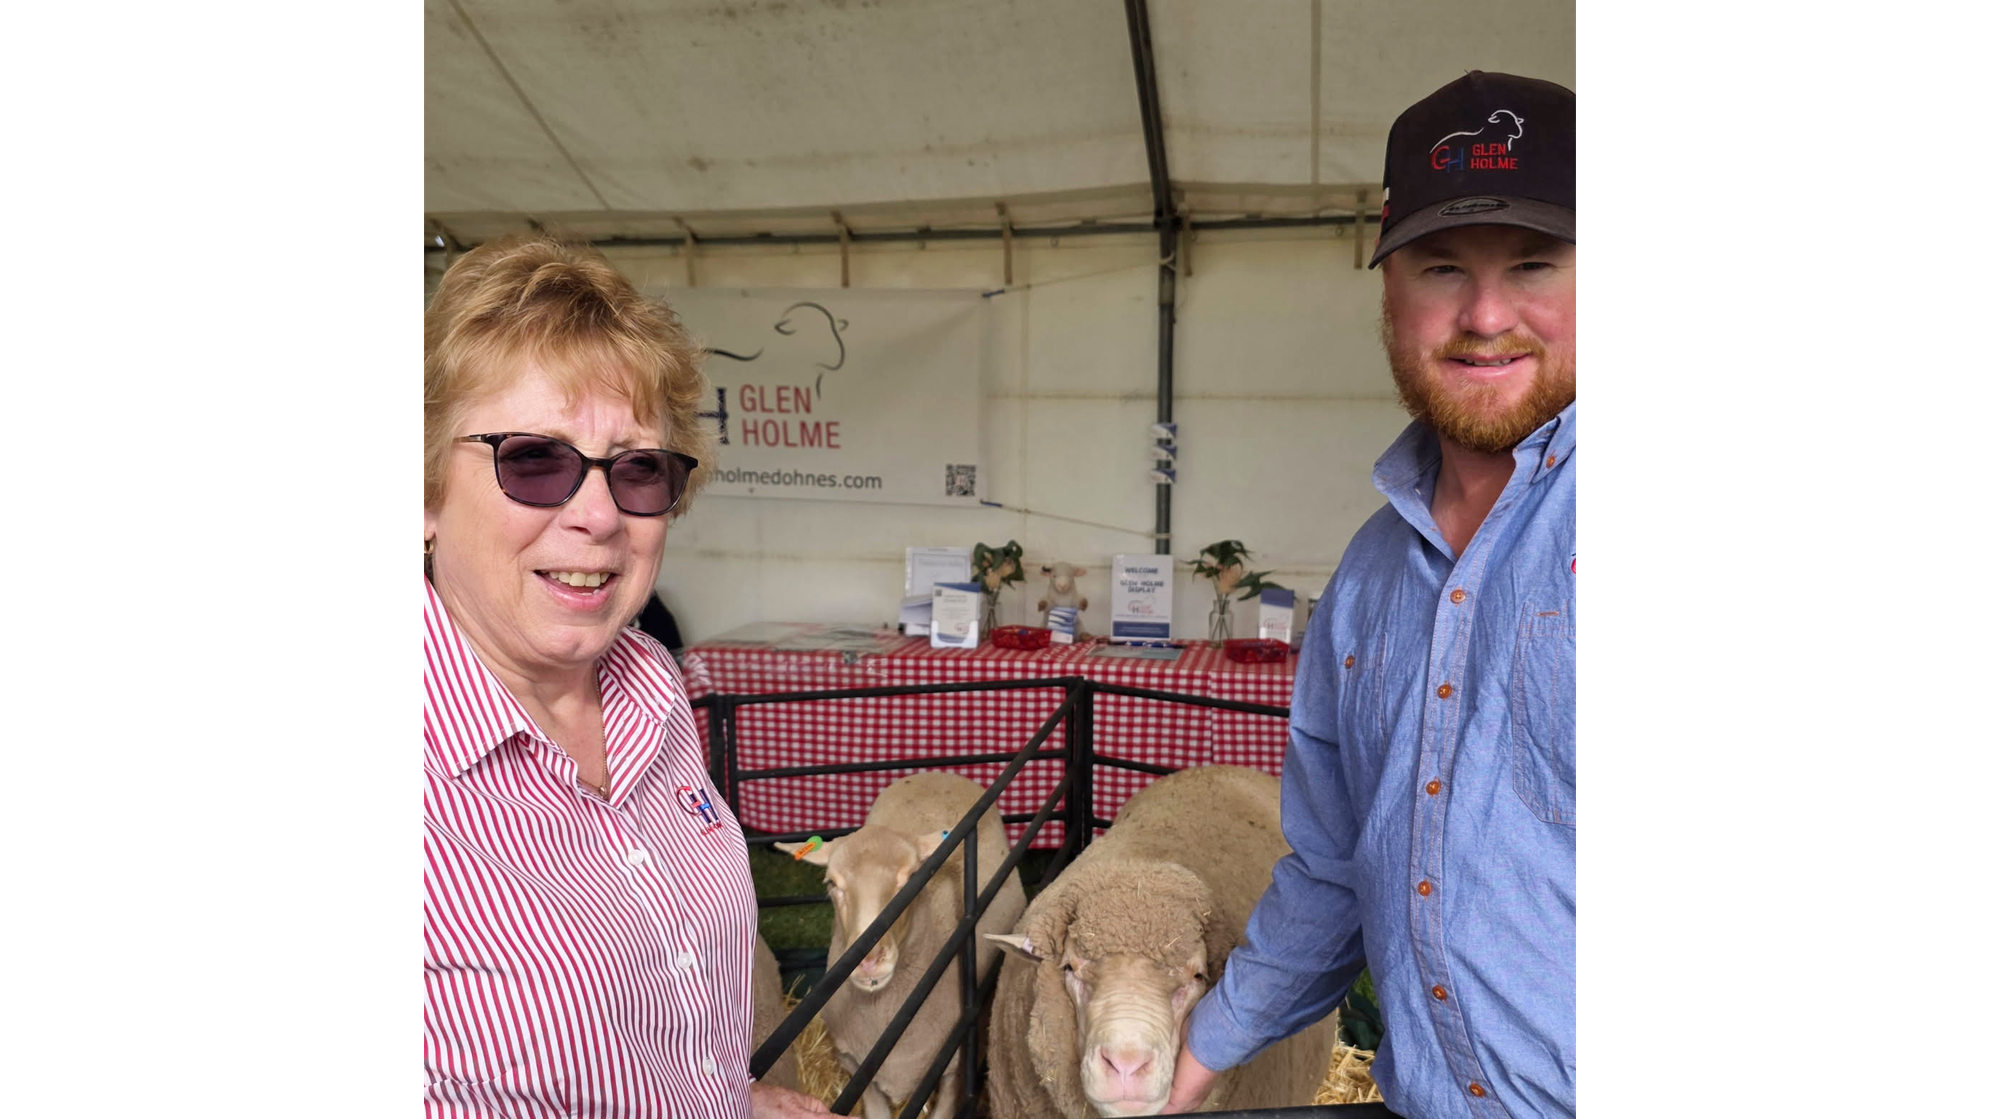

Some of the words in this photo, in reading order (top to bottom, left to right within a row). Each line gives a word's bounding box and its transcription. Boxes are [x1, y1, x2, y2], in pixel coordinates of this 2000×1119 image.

[1431, 145, 1464, 173] GH
[1470, 157, 1519, 170] HOLME
[1472, 143, 1506, 156] GLEN
[739, 383, 812, 414] GLEN
[694, 386, 730, 445] H
[741, 418, 841, 449] HOLME
[711, 467, 882, 489] holmedohnes.com
